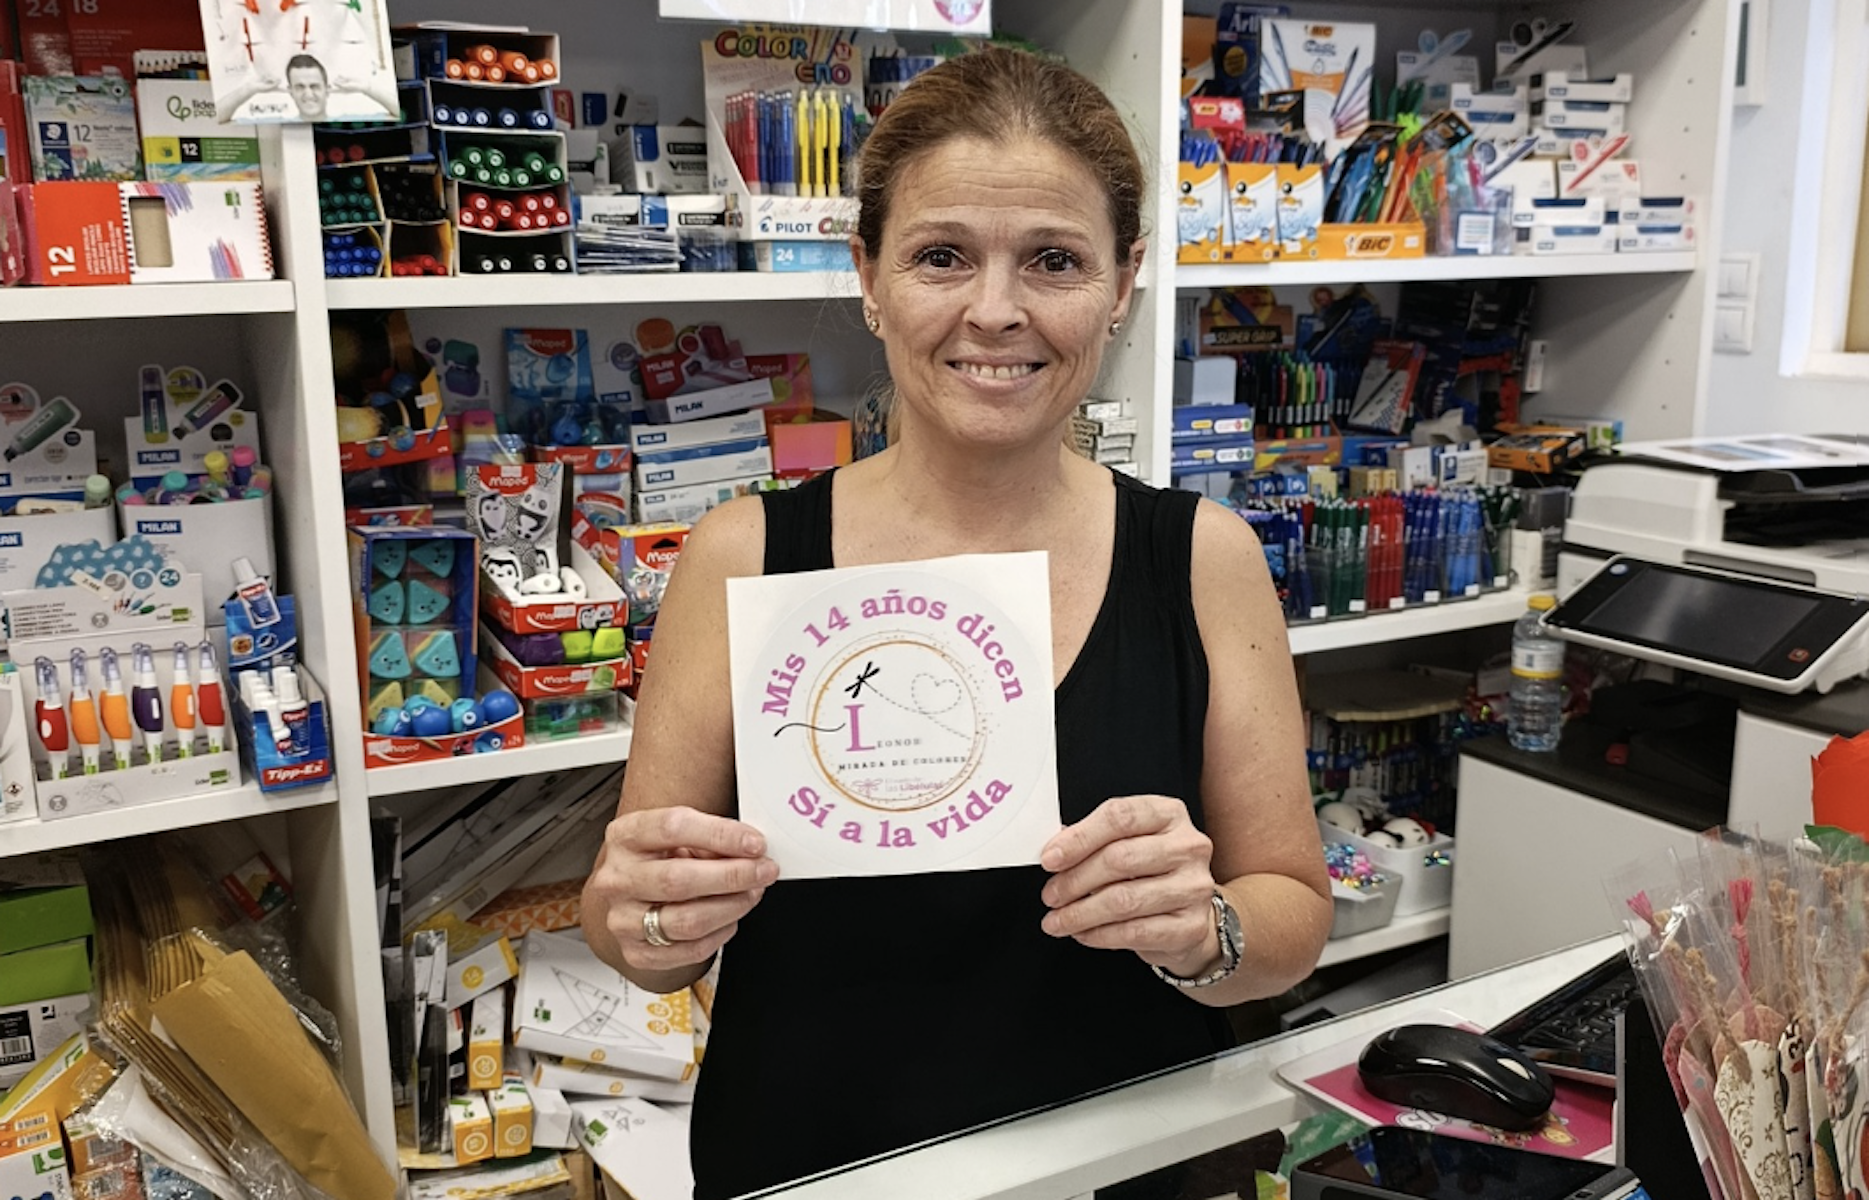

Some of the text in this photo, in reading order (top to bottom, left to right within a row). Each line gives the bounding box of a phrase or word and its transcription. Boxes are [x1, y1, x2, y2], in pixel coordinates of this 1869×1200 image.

[714, 29, 809, 60] COLOR
[73, 124, 92, 142] 12
[181, 143, 199, 156] 12
[775, 223, 813, 233] PILOT
[47, 245, 77, 277] 12
[776, 249, 794, 262] 24
[1215, 331, 1277, 344] SUPER GRIP
[645, 360, 676, 372] MILAN
[675, 401, 704, 414] MILAN
[639, 434, 665, 444] MILAN
[141, 451, 177, 462] MILAN
[649, 471, 673, 481] MILAN
[141, 522, 178, 533] MILAN
[161, 572, 179, 583] 24
[761, 589, 1024, 717] Mis 14 años dicen
[838, 756, 966, 771] MIRADA DE COLORES
[267, 764, 324, 782] Tipp-Ex
[787, 778, 1013, 848] Sí a la vida
